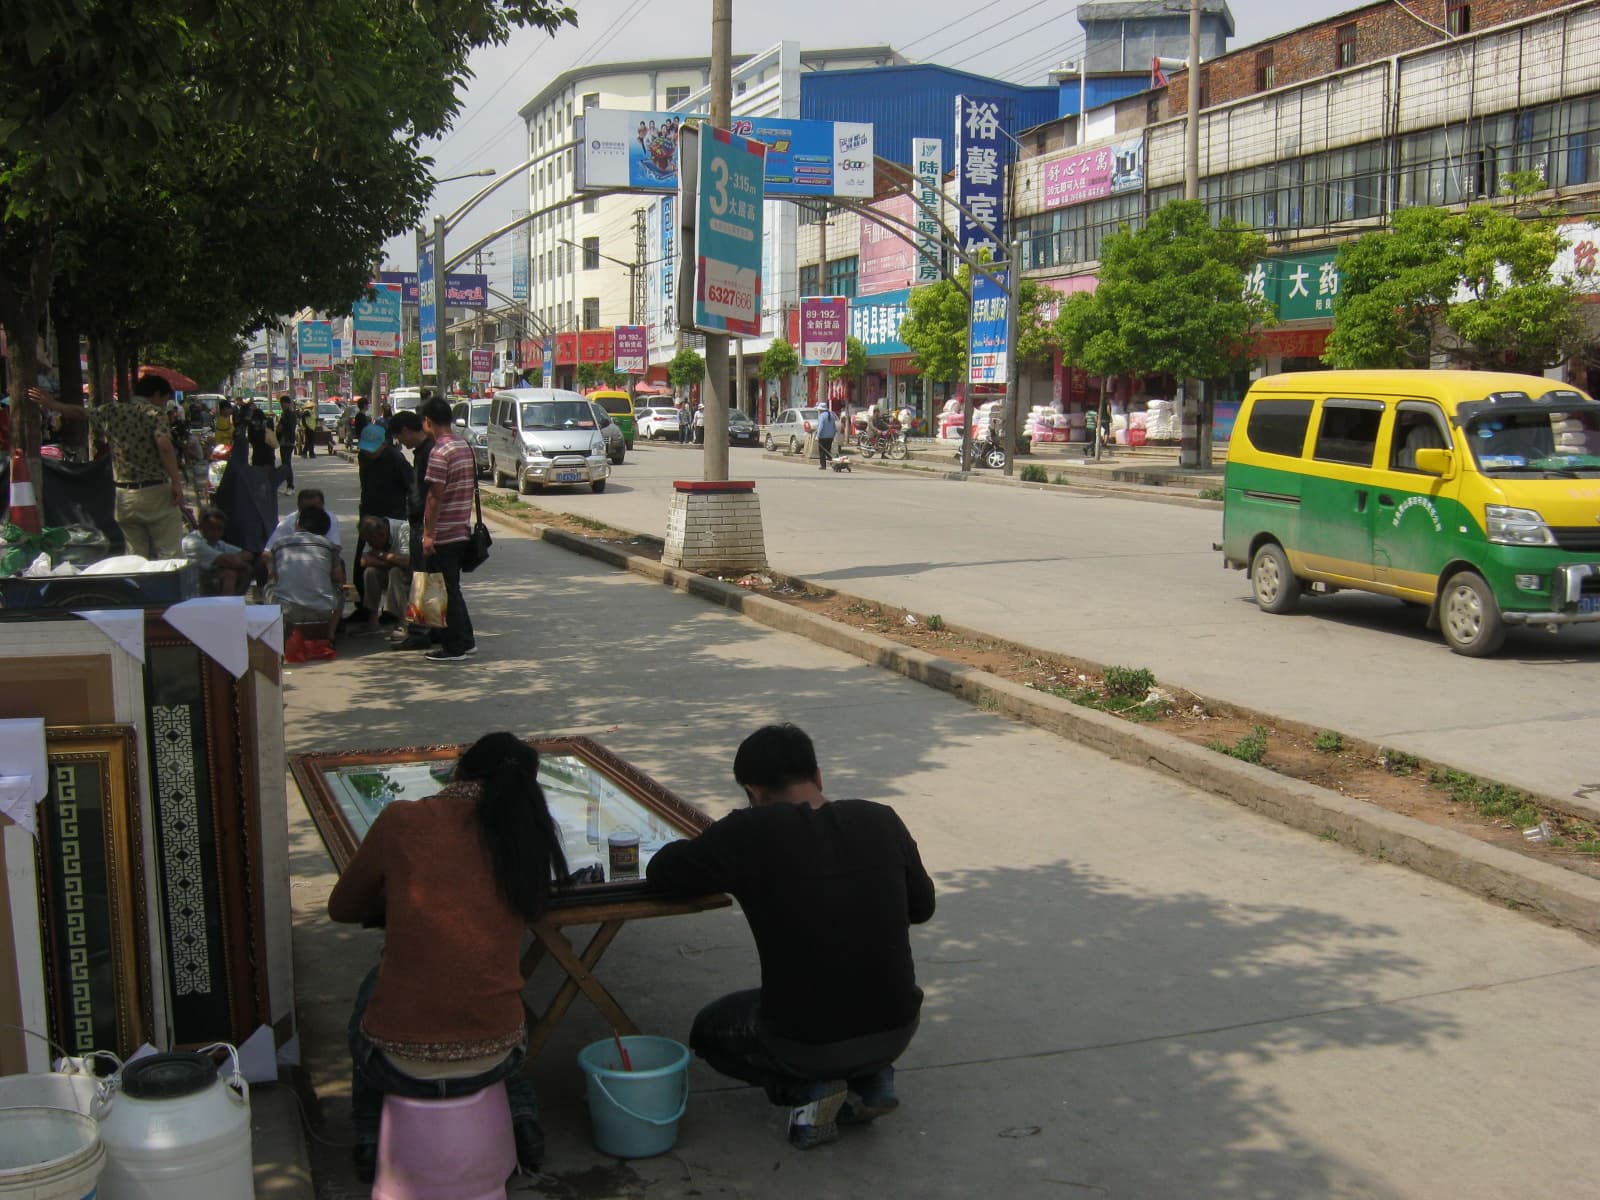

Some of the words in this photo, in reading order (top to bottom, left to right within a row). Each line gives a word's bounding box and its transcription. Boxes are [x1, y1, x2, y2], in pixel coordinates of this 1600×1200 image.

[708, 285, 752, 310] 6327666
[807, 320, 840, 329] 全新货品
